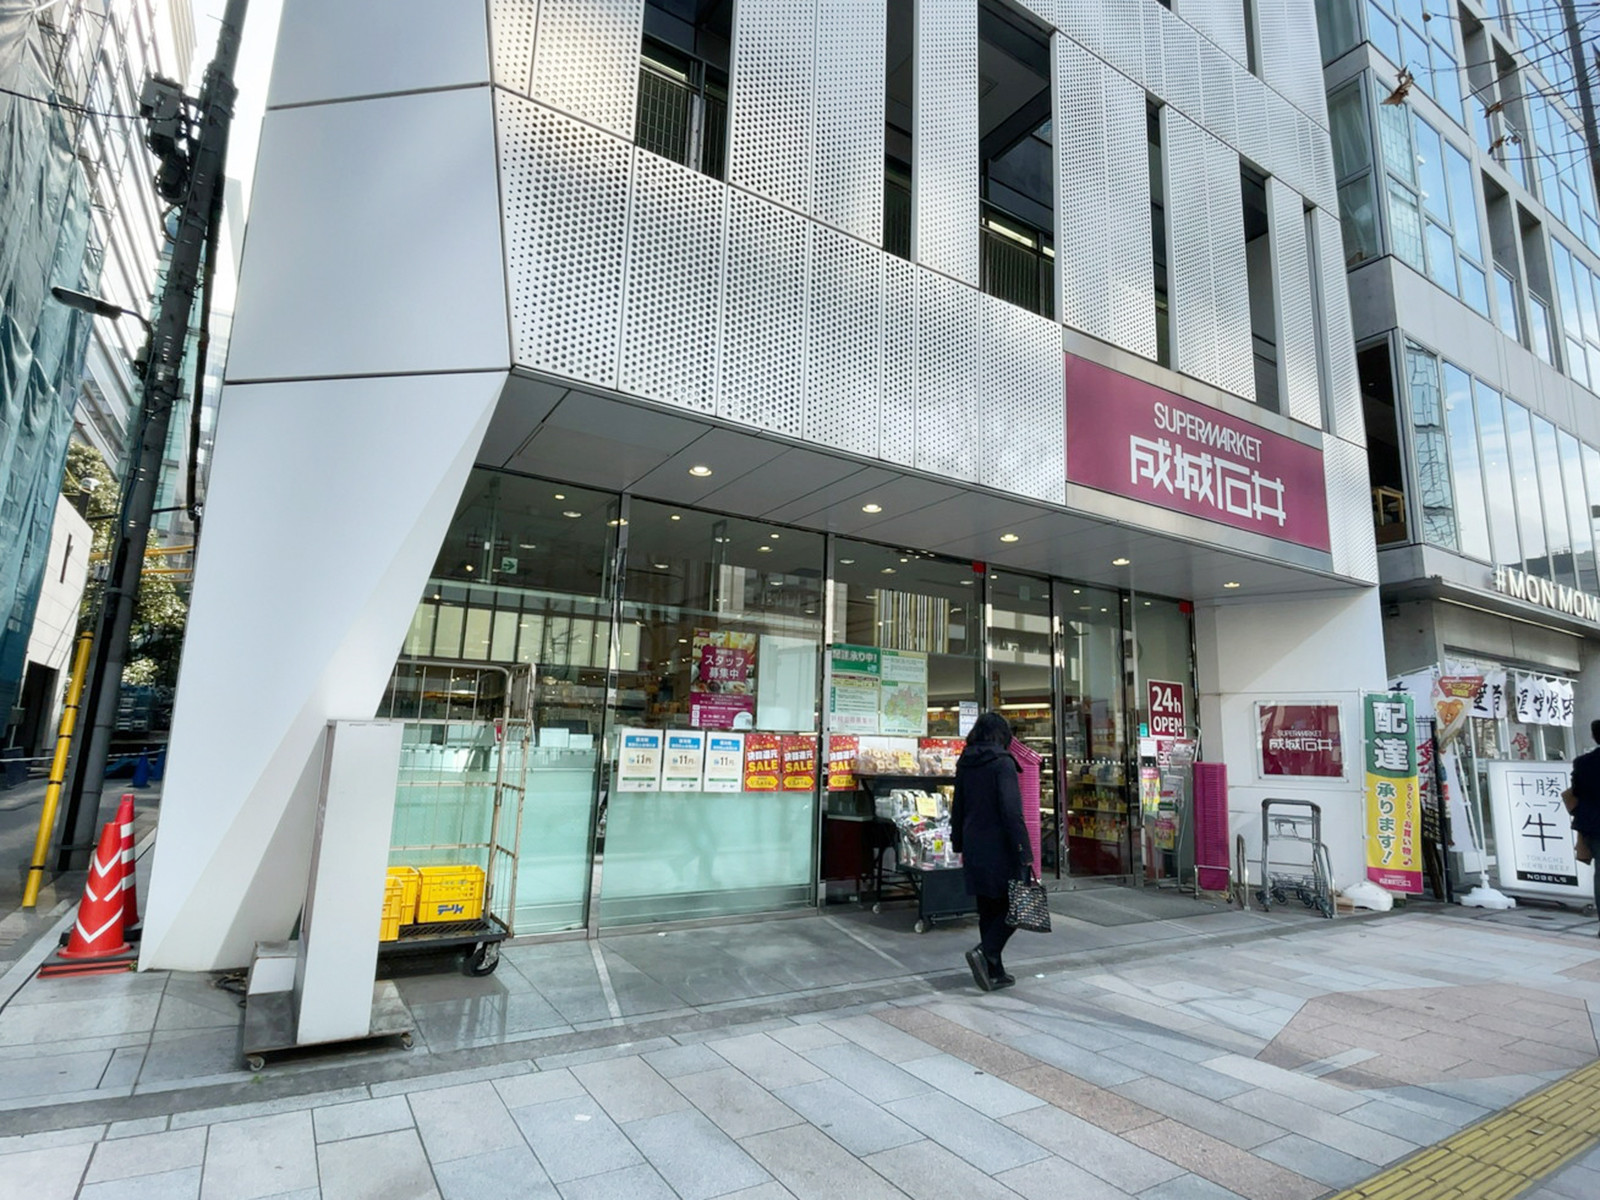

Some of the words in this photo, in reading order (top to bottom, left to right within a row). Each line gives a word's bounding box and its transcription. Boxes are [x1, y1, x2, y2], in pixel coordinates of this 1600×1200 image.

[1153, 402, 1262, 463] SUPERMARKET
[1130, 434, 1287, 528] 成城石井
[705, 654, 745, 668] スタッフ
[709, 666, 739, 680] 募集中
[1151, 685, 1181, 714] 24h
[1152, 715, 1183, 734] OPEN
[1269, 738, 1333, 752] 成城石井
[1372, 702, 1409, 772] 配達
[748, 760, 778, 772] SALE
[785, 760, 814, 772] SALE
[1513, 776, 1562, 798] 十勝
[1376, 782, 1396, 864] 承ります!
[1521, 812, 1564, 852] 牛
